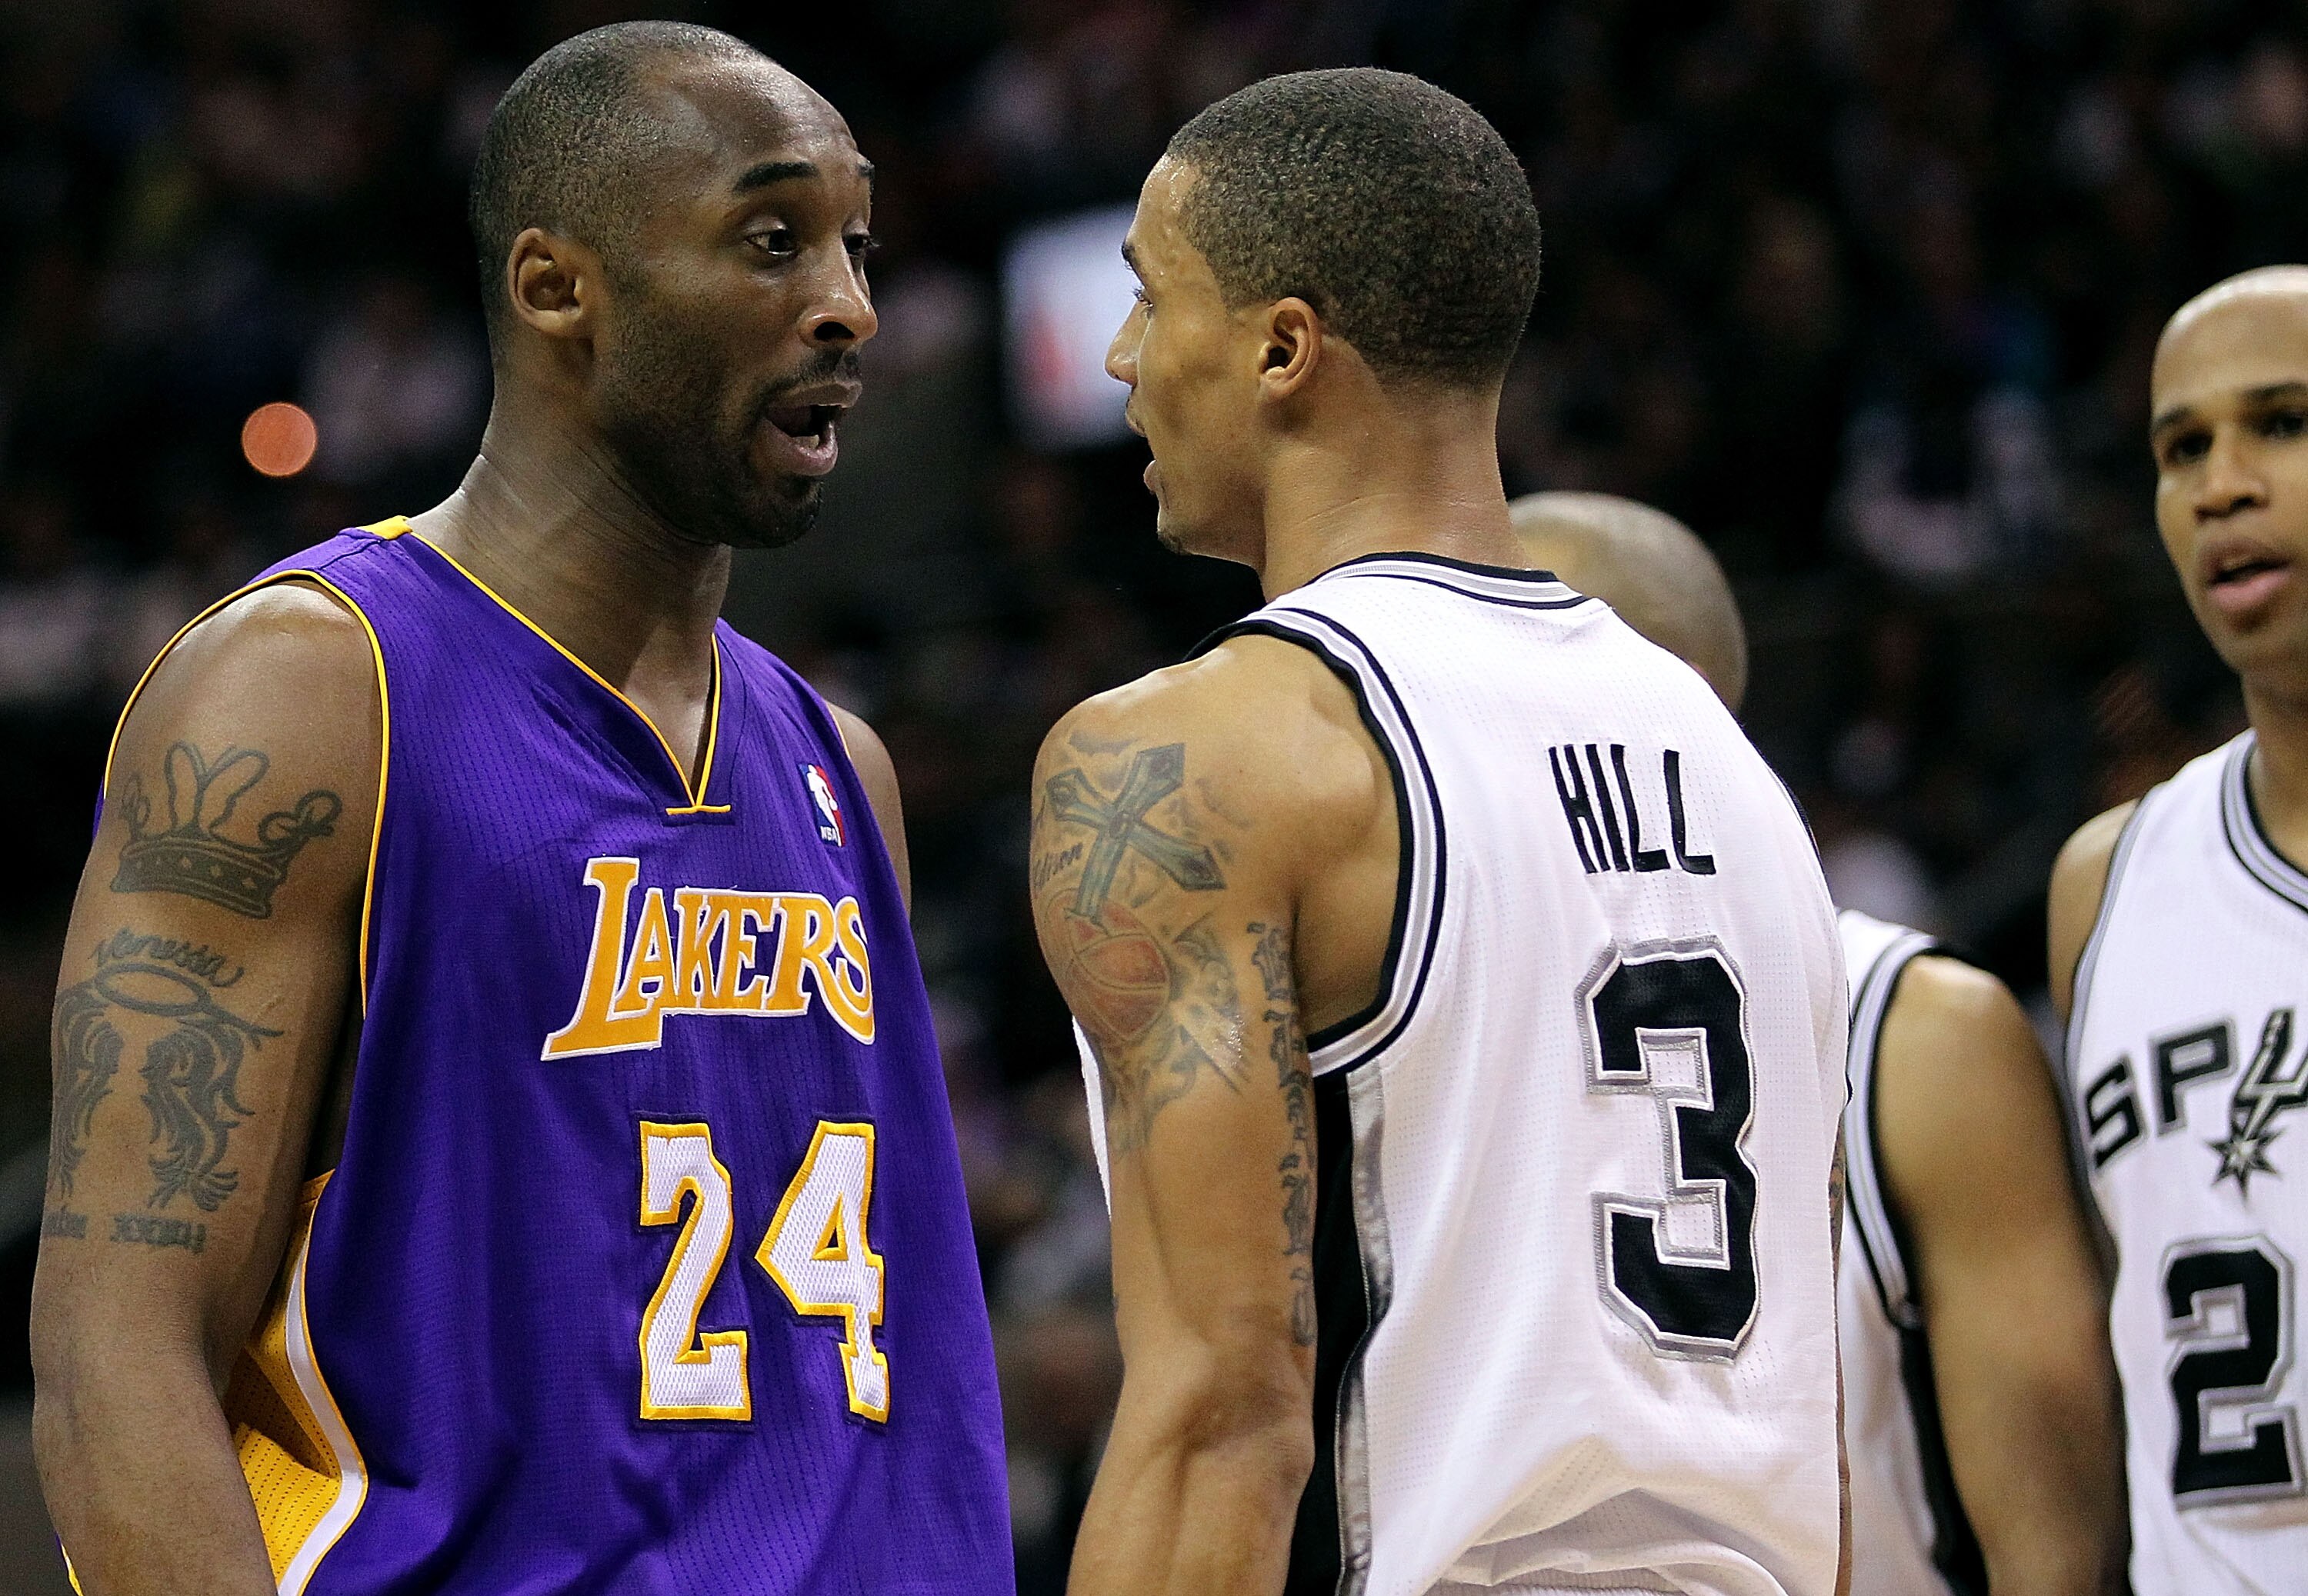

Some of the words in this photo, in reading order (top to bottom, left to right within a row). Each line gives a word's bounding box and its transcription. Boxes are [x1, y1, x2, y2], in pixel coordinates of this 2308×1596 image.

[1548, 744, 1717, 875] HILL
[542, 857, 876, 1061] LAKERS
[639, 1120, 890, 1424] 24
[1573, 934, 1762, 1363] 3
[2160, 1233, 2308, 1512] 2
